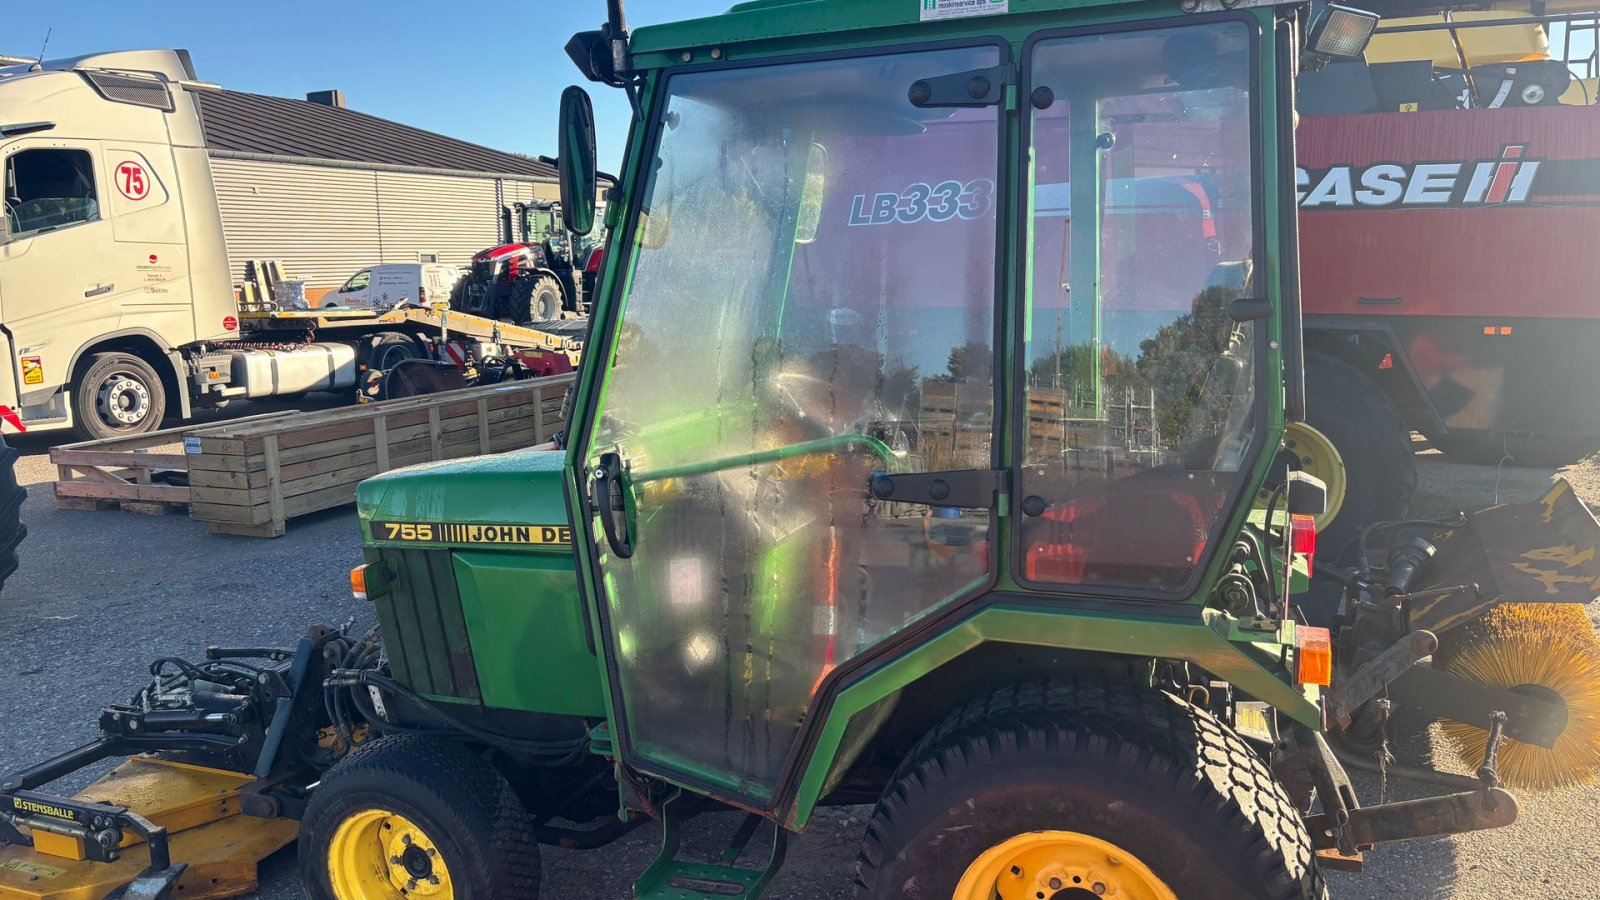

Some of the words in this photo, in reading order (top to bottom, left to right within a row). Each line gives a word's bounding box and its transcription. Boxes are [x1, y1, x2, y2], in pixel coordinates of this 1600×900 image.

[121, 166, 144, 195] 75
[848, 178, 995, 226] LB333
[385, 523, 433, 541] 755
[472, 526, 530, 542] JOHN
[22, 801, 74, 819] STENSBALLE
